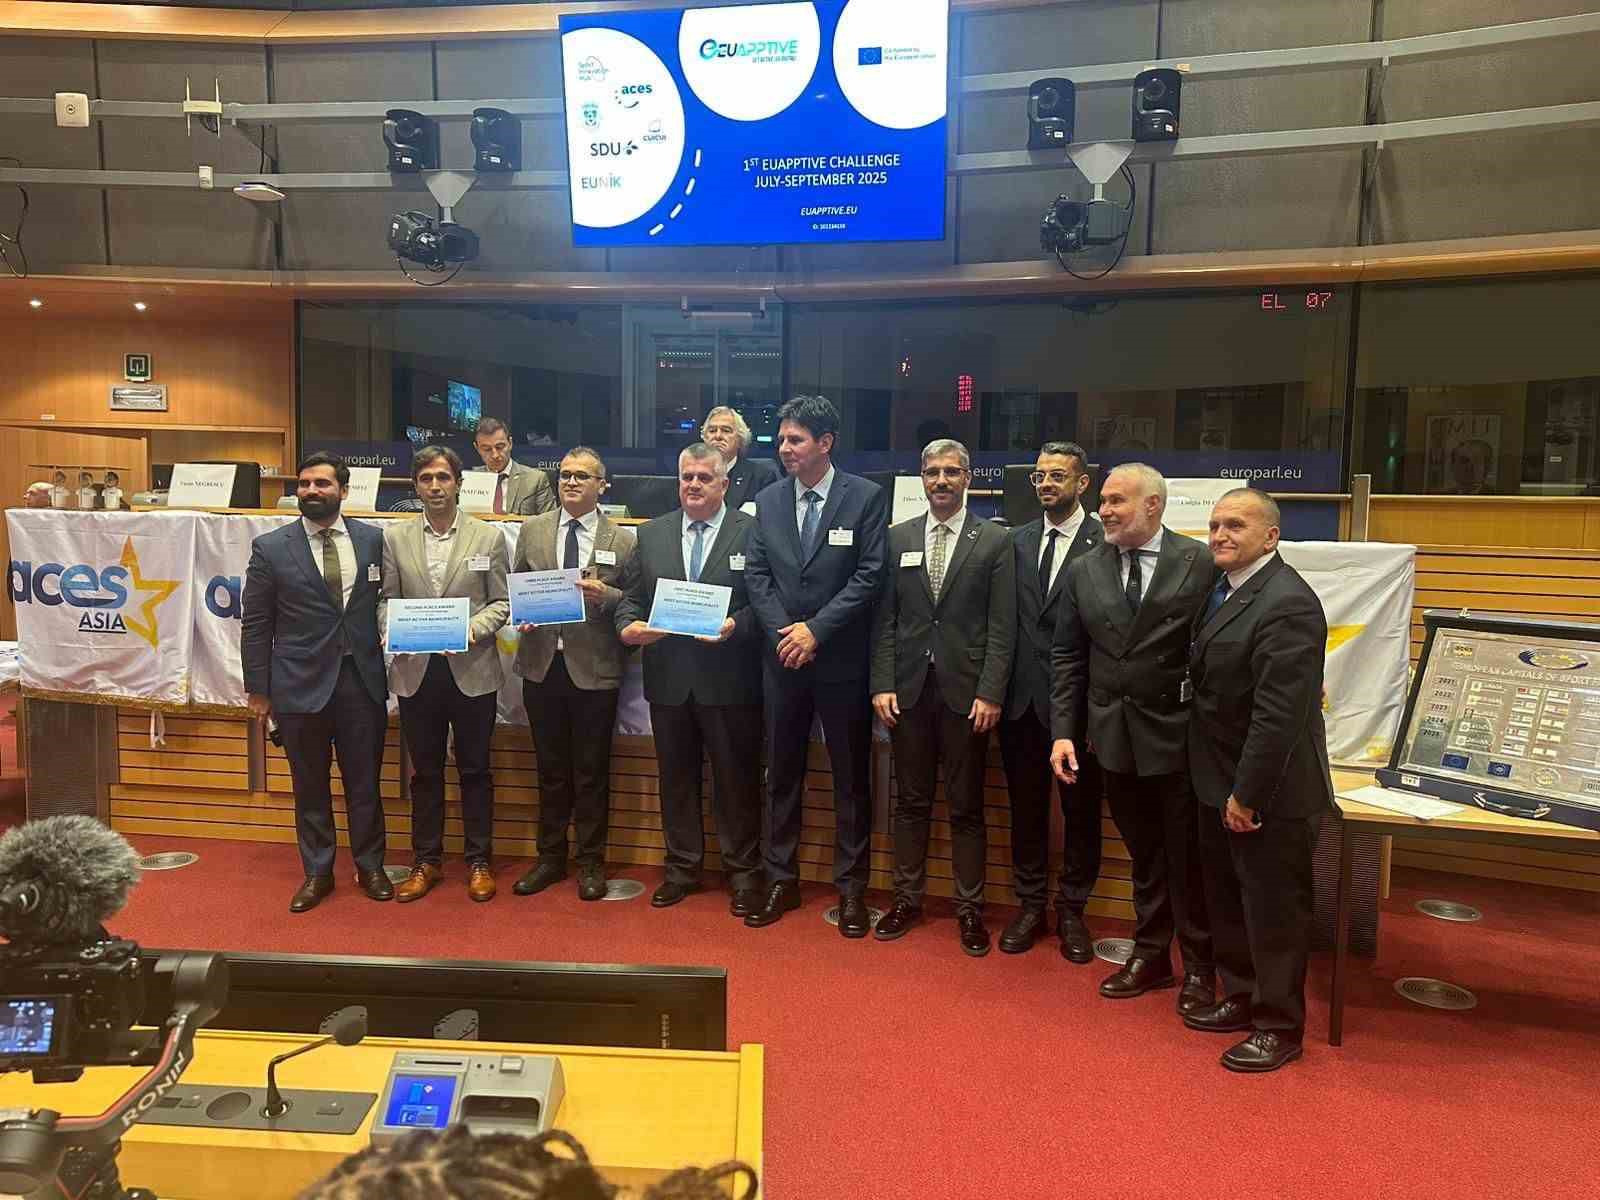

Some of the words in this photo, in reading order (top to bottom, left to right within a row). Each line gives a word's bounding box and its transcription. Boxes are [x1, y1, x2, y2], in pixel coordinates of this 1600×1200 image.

[621, 84, 653, 94] aces
[590, 142, 621, 156] SDU
[762, 156, 827, 171] EUAPPTIVE
[829, 153, 901, 169] CHALLENGE
[755, 172, 855, 188] JULY-SEPTEMBER
[857, 171, 888, 185] 2025
[800, 206, 858, 216] EUAPPTIVE.EU
[1261, 293, 1287, 309] EL
[1306, 292, 1332, 308] 07
[340, 454, 396, 466] uroparl.eu
[1220, 465, 1302, 480] europarl.eu
[8, 559, 129, 609] aces
[79, 611, 127, 630] ASIA
[121, 1051, 185, 1127] RONIN
